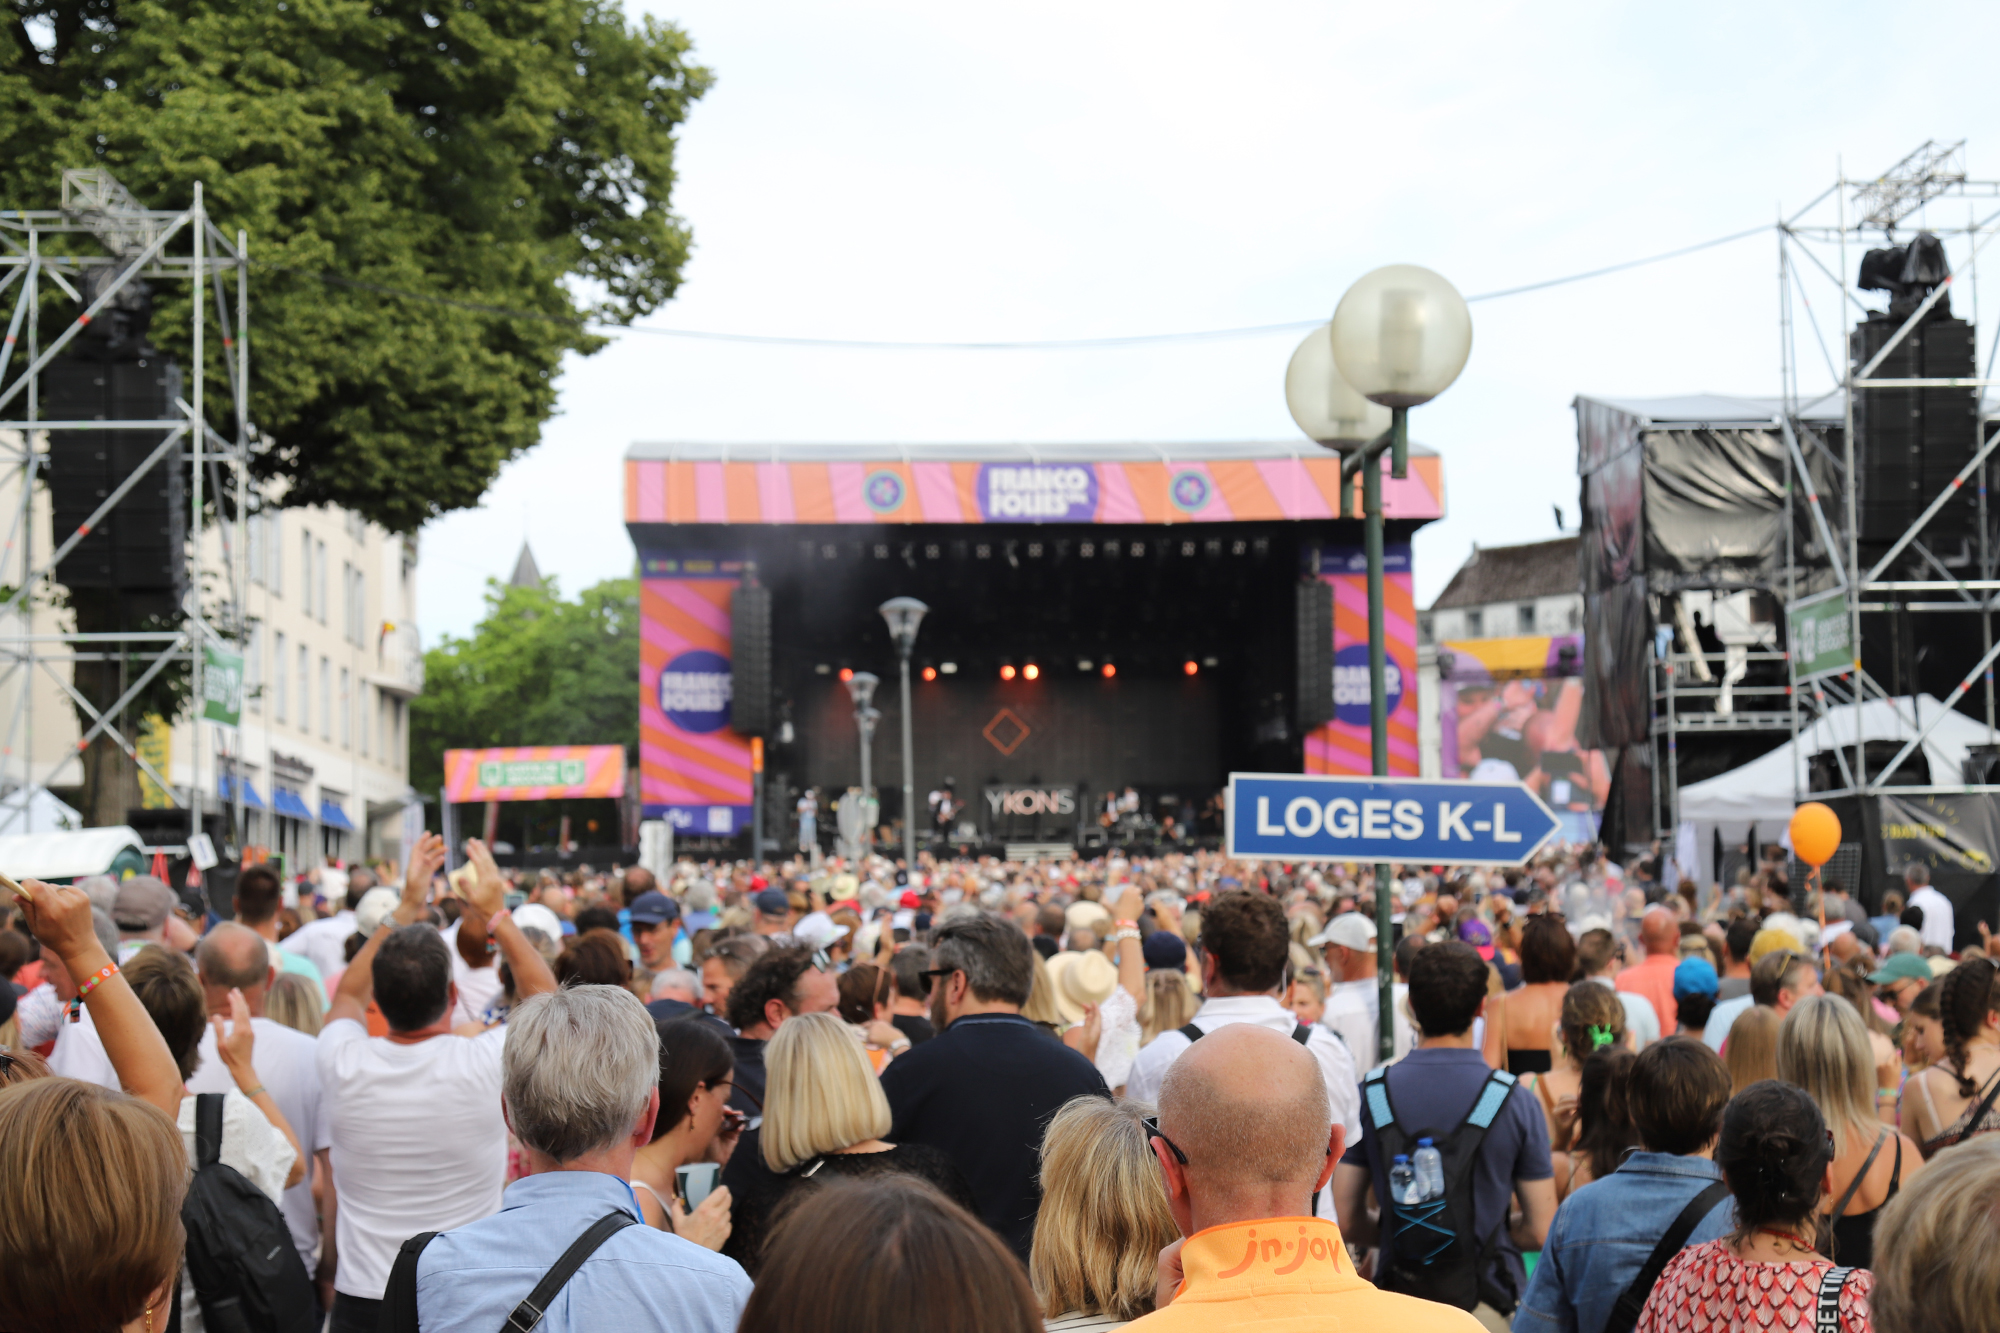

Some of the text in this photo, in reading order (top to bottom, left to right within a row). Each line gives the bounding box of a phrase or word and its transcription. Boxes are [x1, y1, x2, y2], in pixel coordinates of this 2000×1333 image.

[988, 467, 1088, 491] FRANCO
[988, 493, 1069, 517] FOLIES
[985, 788, 1076, 816] YKONS
[1256, 796, 1523, 843] LOGES K-L
